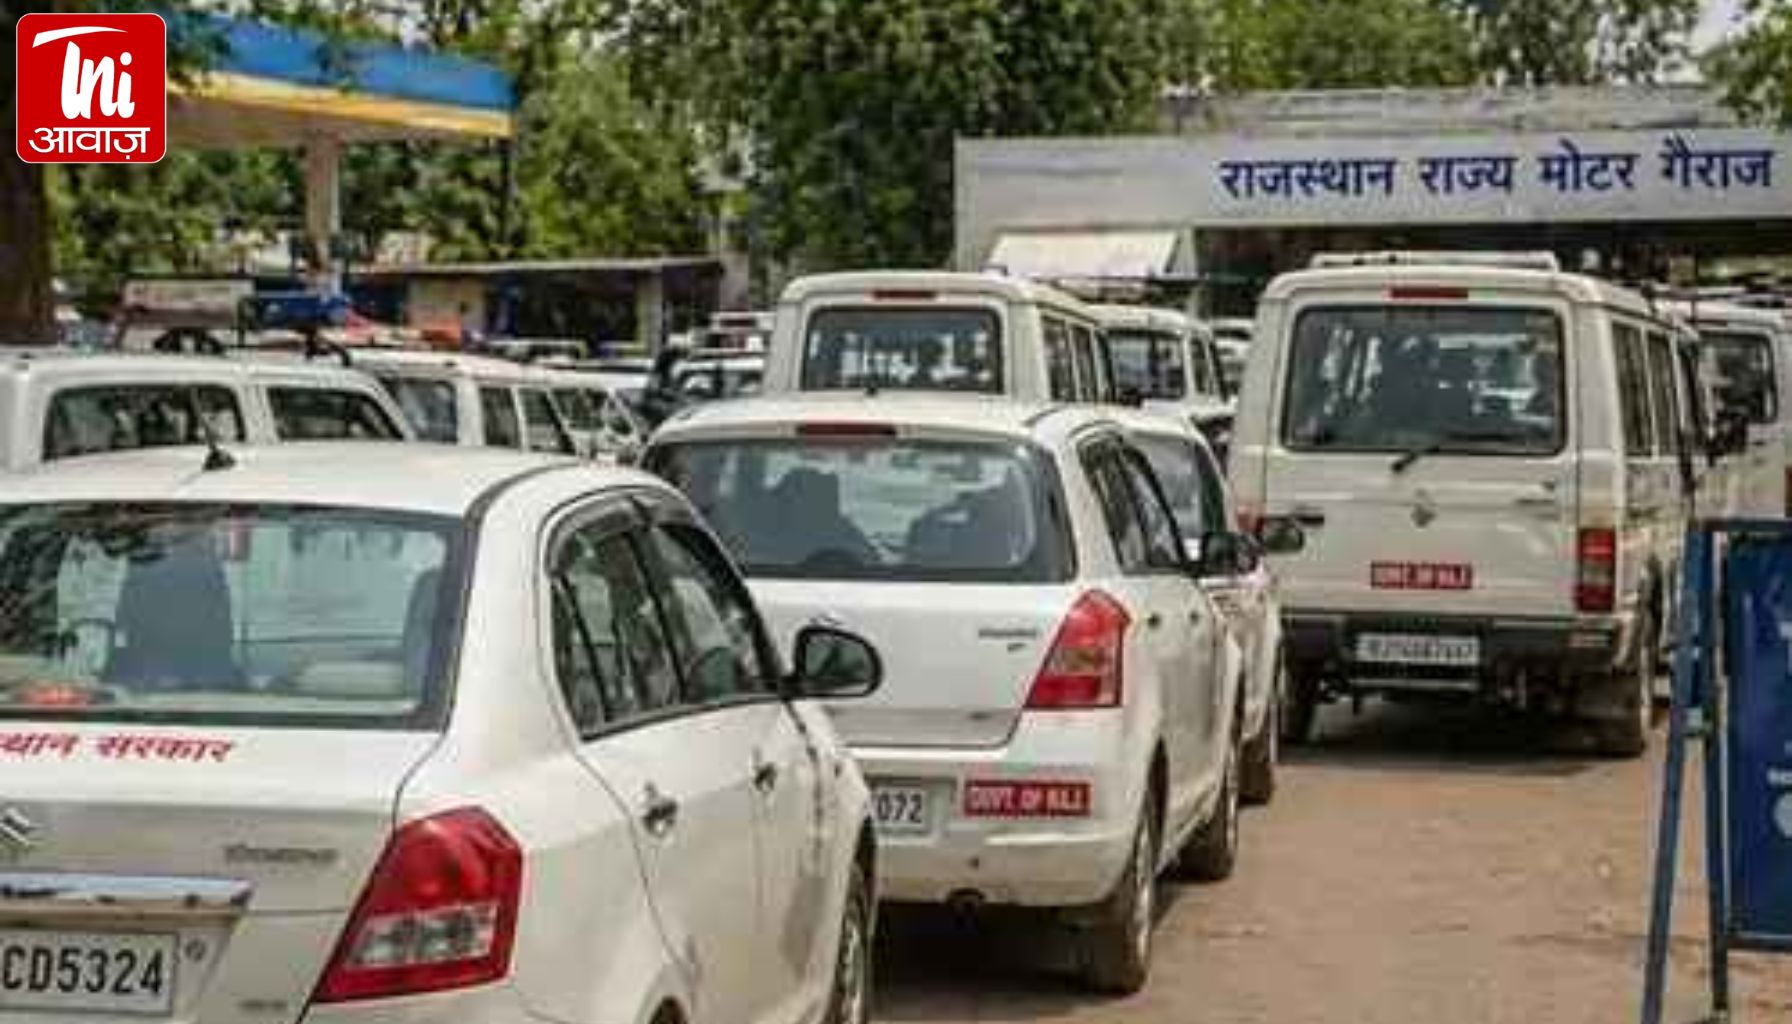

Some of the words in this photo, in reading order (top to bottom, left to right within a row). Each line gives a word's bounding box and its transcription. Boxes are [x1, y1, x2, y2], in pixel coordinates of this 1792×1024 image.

[1219, 156, 1396, 199] राजस्थान
[1419, 155, 1518, 196] राज्य
[1538, 139, 1639, 191] मोटर
[1660, 134, 1774, 189] गैराज
[97, 734, 233, 762] सरकार
[2, 945, 164, 993] CD5324
